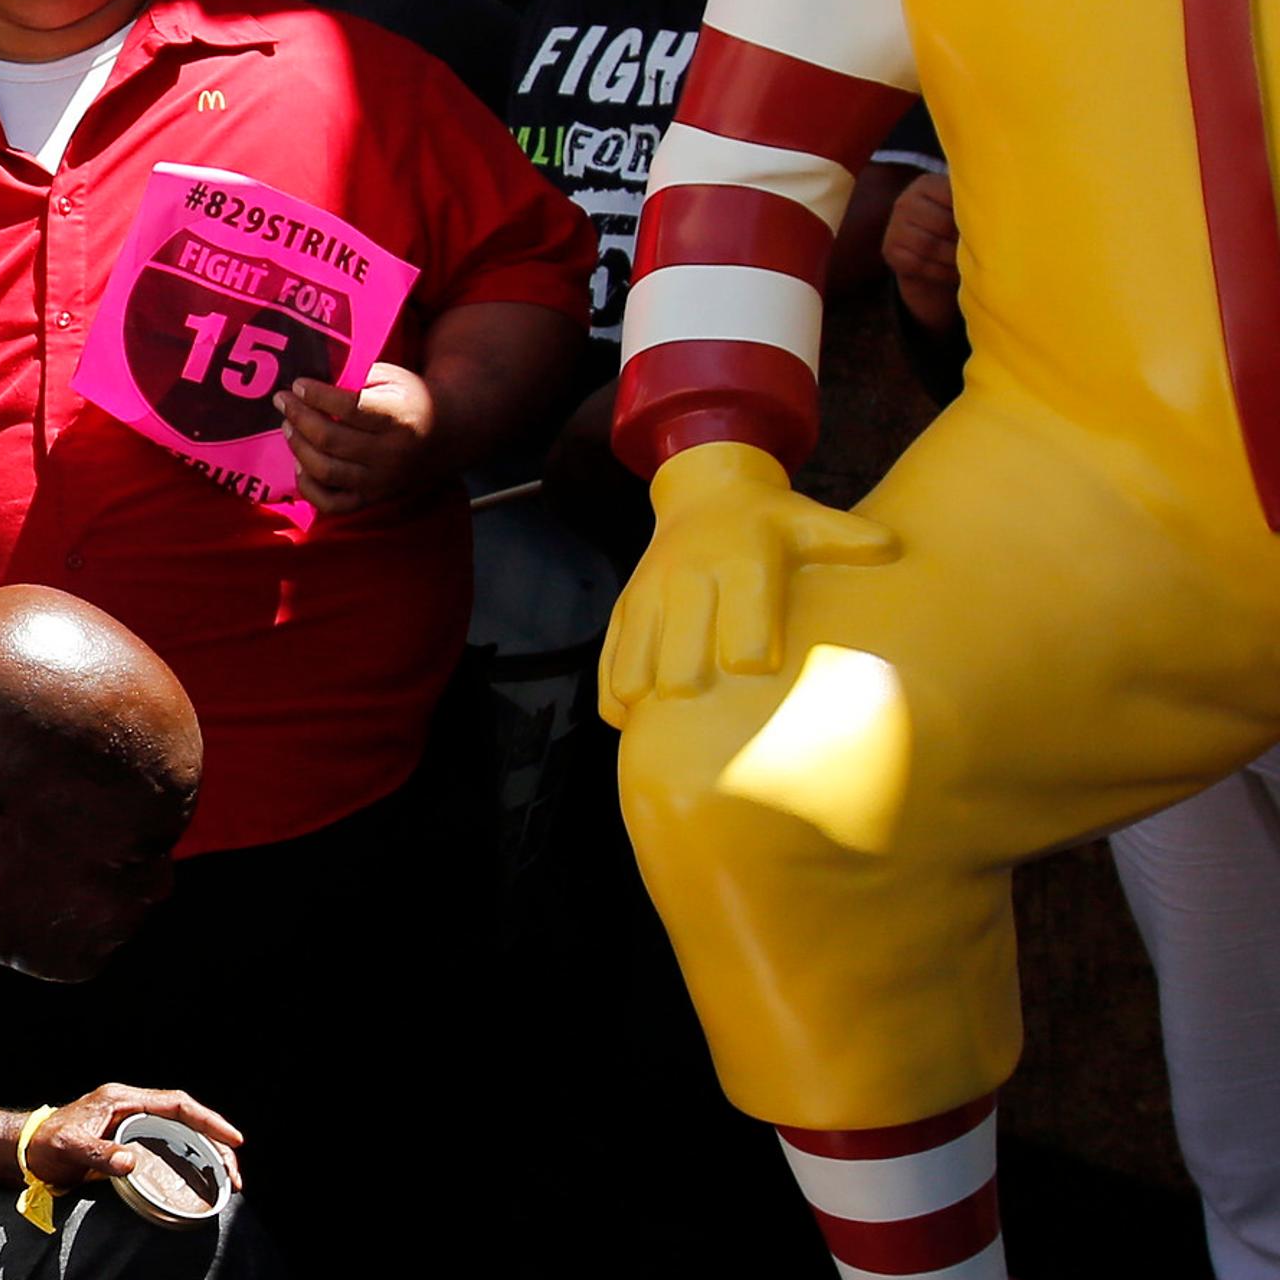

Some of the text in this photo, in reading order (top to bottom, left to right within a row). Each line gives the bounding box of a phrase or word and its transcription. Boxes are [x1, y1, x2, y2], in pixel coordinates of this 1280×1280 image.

[517, 24, 700, 107] FIGH
[184, 181, 371, 286] #829STRIKE
[177, 240, 338, 324] FIGHT FOR
[181, 311, 289, 400] 15
